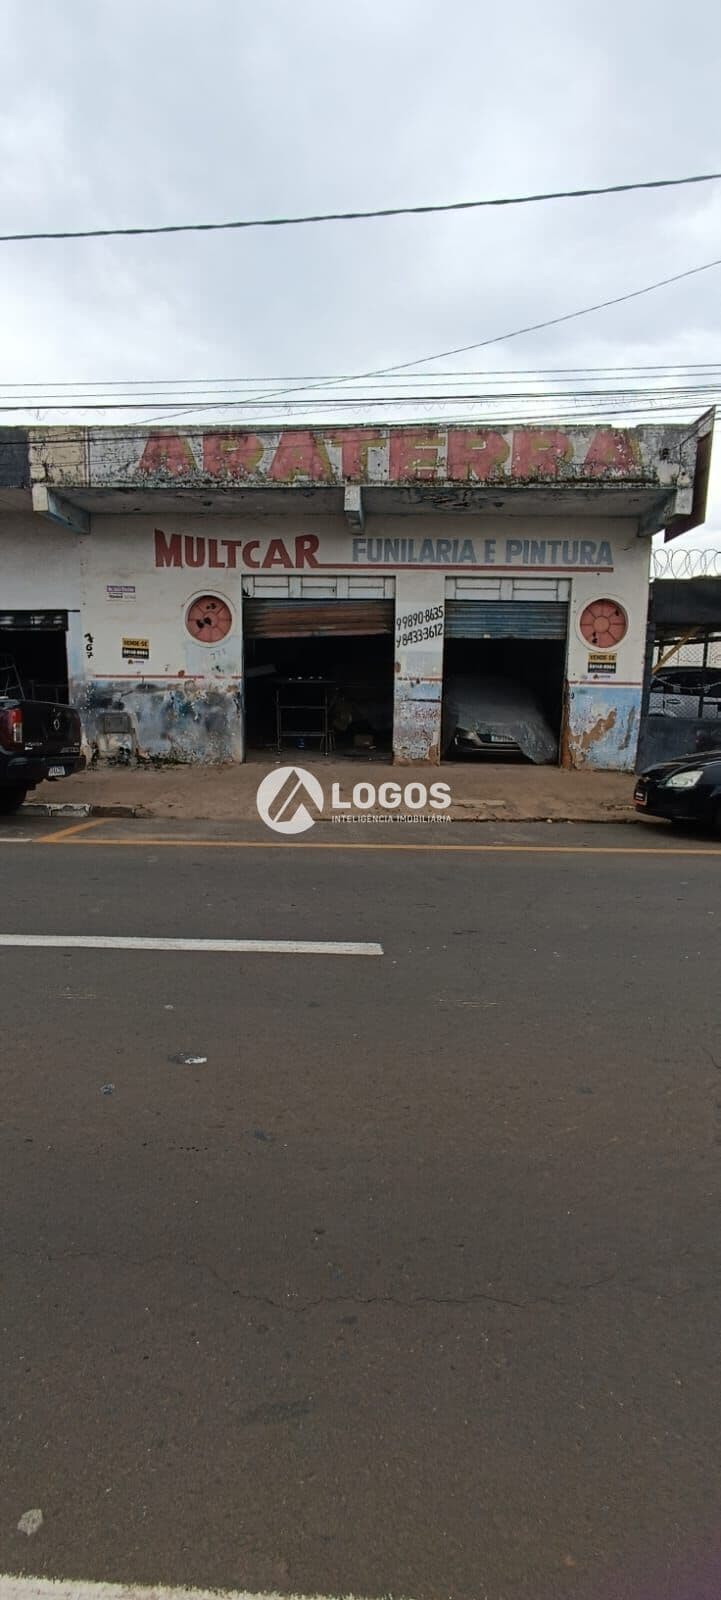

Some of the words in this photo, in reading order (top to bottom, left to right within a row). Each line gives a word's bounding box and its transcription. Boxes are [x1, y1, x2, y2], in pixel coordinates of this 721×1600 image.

[137, 428, 641, 482] ARATERRA
[154, 528, 320, 568] MULTCAR
[352, 537, 477, 563] FUNILARIA
[484, 539, 497, 563] E
[505, 539, 613, 565] PINTURA
